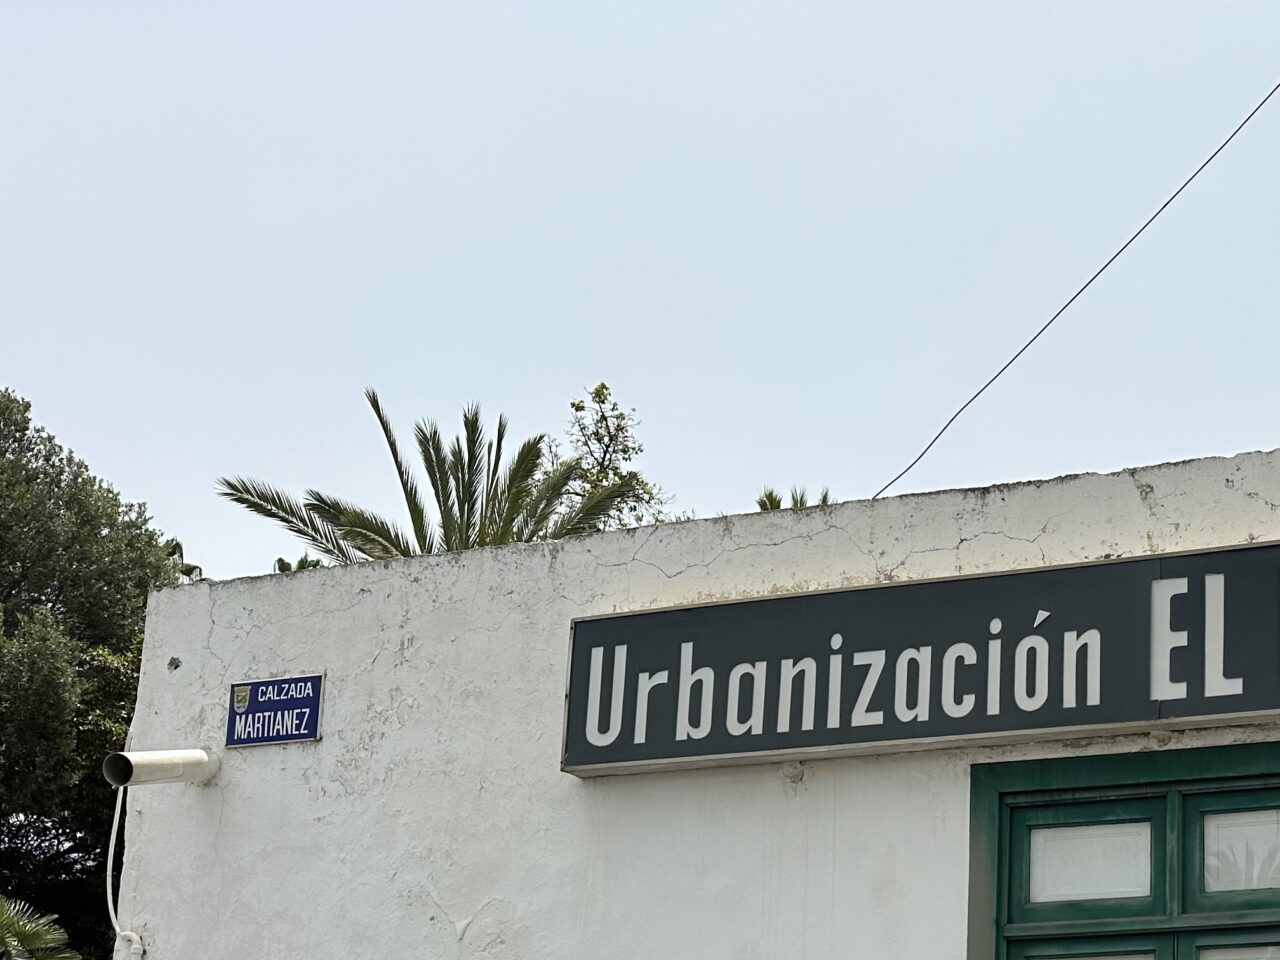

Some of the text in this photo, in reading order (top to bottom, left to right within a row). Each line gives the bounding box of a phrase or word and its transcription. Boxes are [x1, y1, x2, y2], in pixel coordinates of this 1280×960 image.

[585, 609, 1101, 747] Urbanización
[1150, 573, 1243, 700] EL
[258, 682, 313, 701] CALZADA
[234, 708, 310, 740] MARTIANEZ
